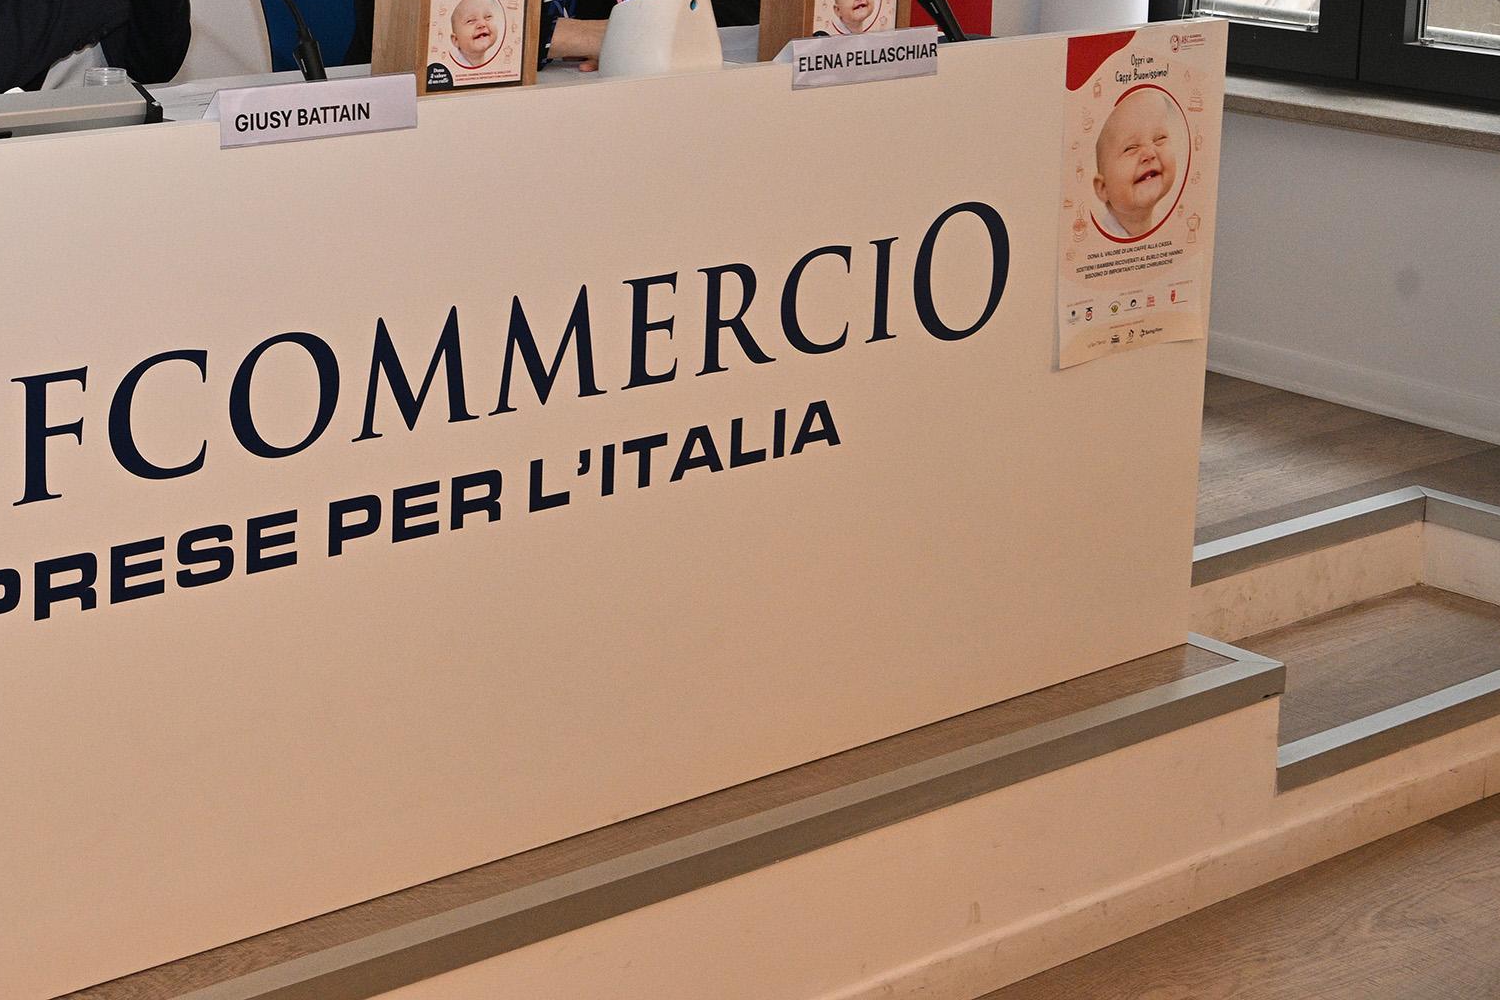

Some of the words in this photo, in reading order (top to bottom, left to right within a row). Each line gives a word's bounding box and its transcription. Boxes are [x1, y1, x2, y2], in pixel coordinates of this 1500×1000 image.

[798, 53, 843, 73] ELENA
[846, 42, 938, 67] PELLASCHIAR
[235, 109, 293, 132] GIUSY
[297, 102, 370, 126] BATTAIN
[327, 468, 503, 559] PER
[528, 399, 842, 514] L'ITALIA
